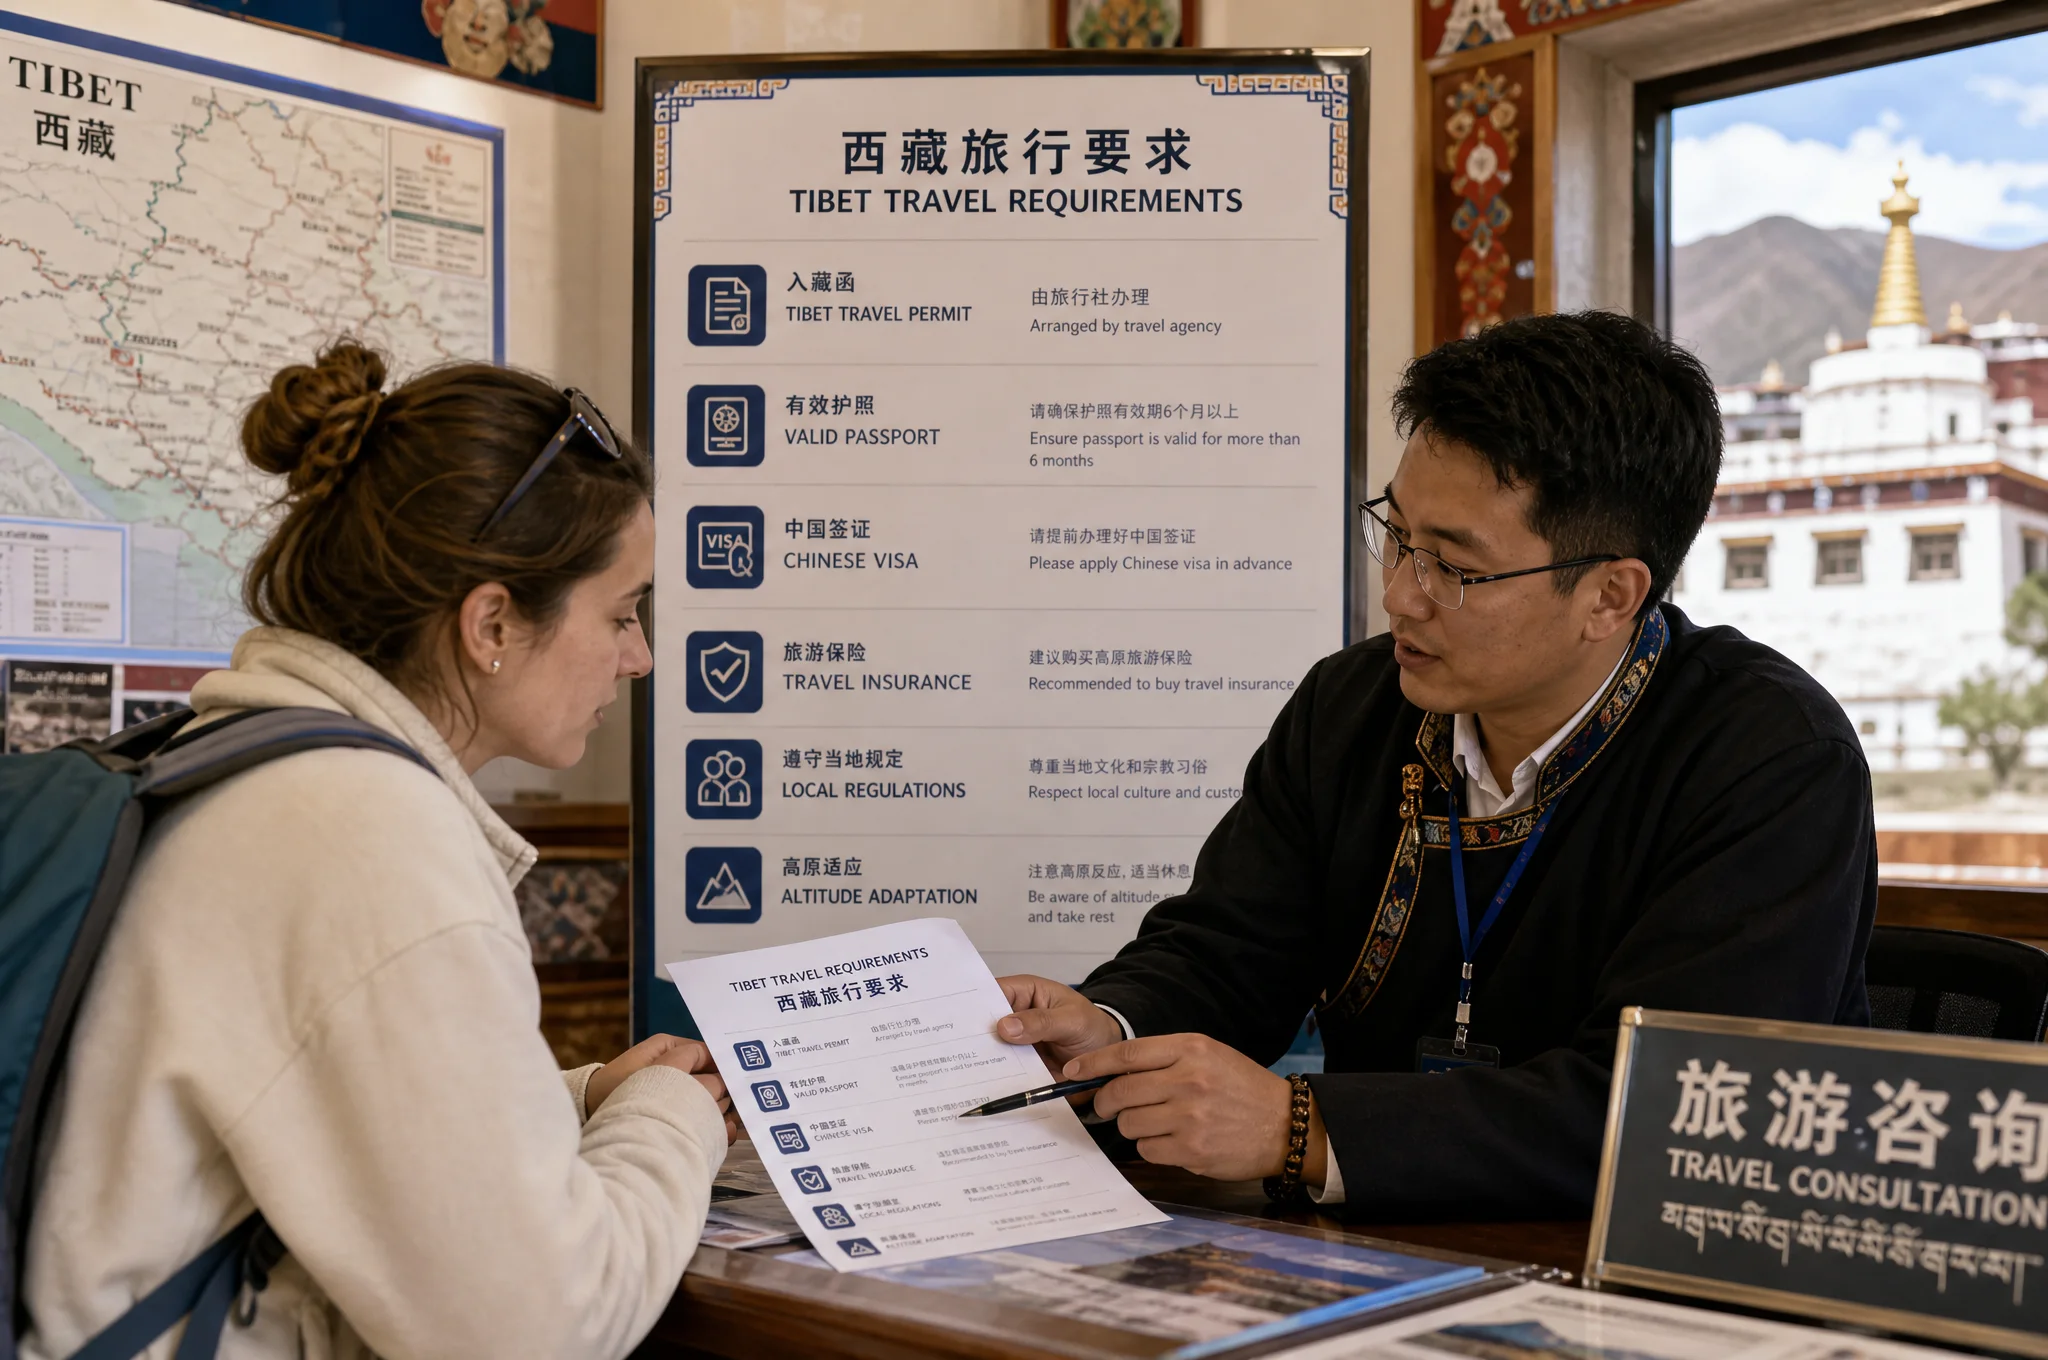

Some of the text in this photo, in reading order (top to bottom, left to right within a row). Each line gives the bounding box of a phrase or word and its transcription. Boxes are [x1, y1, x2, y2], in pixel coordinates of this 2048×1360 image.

[9, 56, 141, 112] TIBET
[34, 110, 116, 161] 西藏
[842, 128, 1191, 175] 西藏旅行要求
[790, 188, 1242, 218] TIBET TRAVEL REQUIREMENTS
[787, 271, 854, 292] 入藏函
[1032, 288, 1149, 306] 由旅行社办理
[786, 306, 972, 321] TIBET TRAVEL PERMIT
[1030, 318, 1222, 336] Arranged by travel agency
[786, 395, 874, 415] 有效护照
[1030, 403, 1238, 419] 请确保护照有效期6个月以上
[785, 429, 940, 445] VALID PASSPORT
[1031, 431, 1300, 448] Ensure passport is valid for more than
[1030, 454, 1093, 467] 6 months
[786, 518, 870, 539] 中国签证
[1030, 528, 1195, 544] 请提前办理好中国签证
[706, 534, 743, 549] VISA
[784, 552, 918, 569] CHINESE VISA
[1030, 556, 1292, 573] Please apply Chinese visa in advance
[784, 642, 866, 662] 旅游保险
[1029, 649, 1192, 665] 建议购买高原旅游保险
[783, 674, 971, 690] TRAVEL INSURANCE
[1029, 677, 1294, 693] Recommended to buy travel insurance
[783, 749, 903, 769] 遵守当地规定
[1029, 758, 1207, 774] 尊重当地文化和宗教习俗
[783, 782, 966, 798] LOCAL REGULATIONS
[1029, 785, 1242, 801] Respect local culture and custo
[783, 857, 862, 876] 高原适应
[781, 889, 977, 904] ALTITUDE ADAPTATION
[1029, 890, 1044, 902] Be
[1050, 894, 1088, 902] aware
[1094, 890, 1106, 902] of
[1111, 890, 1159, 902] altitude
[1028, 910, 1115, 923] and take rest
[729, 947, 929, 993] TIBET TRAVEL REQUIREMENTS
[774, 973, 909, 1013] 西藏旅行要求
[775, 1048, 796, 1058] TIBET
[797, 1044, 823, 1054] TRAVEL
[794, 1081, 859, 1099] VALID PASSPORT
[1670, 1058, 2048, 1182] 旅游咨询
[814, 1126, 874, 1142] CHINESE VISA
[836, 1174, 867, 1184] TRAVEL
[1667, 1147, 2047, 1230] TRAVEL CONSULTATION
